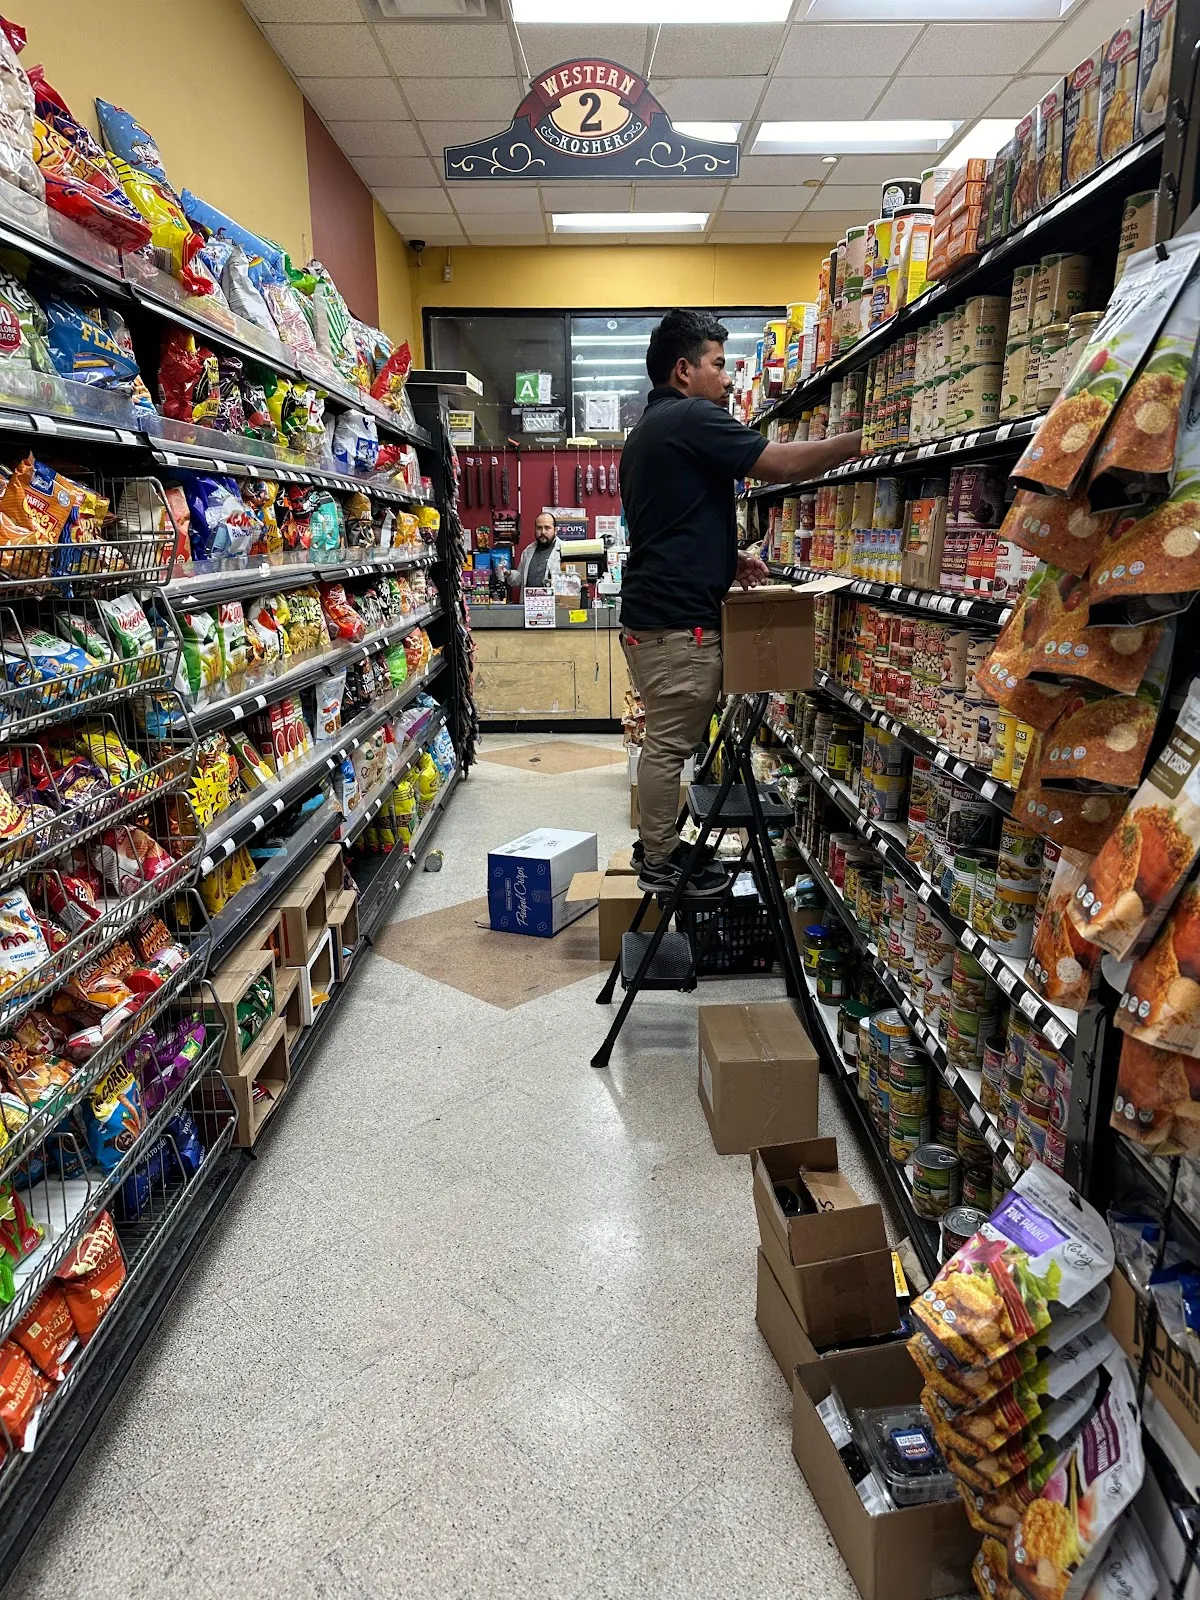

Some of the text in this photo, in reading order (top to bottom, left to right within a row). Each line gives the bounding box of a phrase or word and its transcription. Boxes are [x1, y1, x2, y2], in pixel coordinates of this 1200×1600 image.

[540, 65, 636, 97] WESTERN
[579, 92, 602, 132] 2
[558, 134, 624, 154] KOSHER
[1121, 222, 1138, 234] earts
[520, 380, 535, 398] A
[513, 866, 532, 926] Pretzel Crisps
[9, 950, 36, 960] ORIGINAL
[1003, 1206, 1050, 1243] FINE PANKO
[24, 1235, 37, 1249] CHILI
[1067, 1242, 1096, 1273] Pereg
